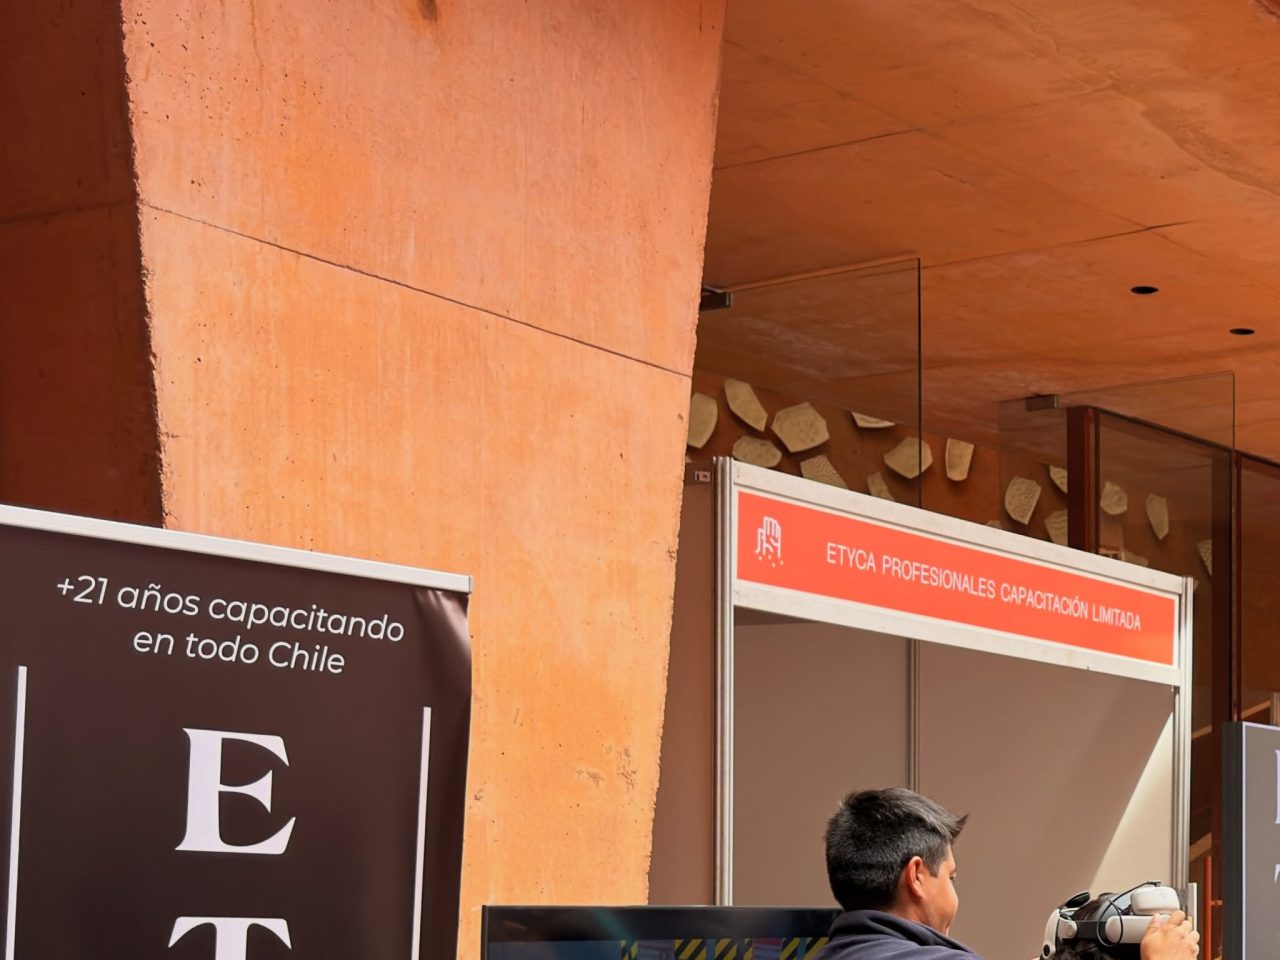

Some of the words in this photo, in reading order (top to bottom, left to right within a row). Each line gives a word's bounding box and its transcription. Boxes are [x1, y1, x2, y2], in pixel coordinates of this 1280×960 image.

[57, 575, 107, 605] +21
[117, 583, 200, 617] años
[208, 597, 405, 643] capacitando
[826, 542, 877, 573] ETYCA
[881, 554, 996, 599] PROFESIONALES
[1000, 582, 1089, 619] CAPACITACIÓN
[1091, 603, 1142, 631] LIMITADA
[133, 629, 174, 655] en
[186, 632, 259, 664] todo
[269, 641, 346, 674] Chile
